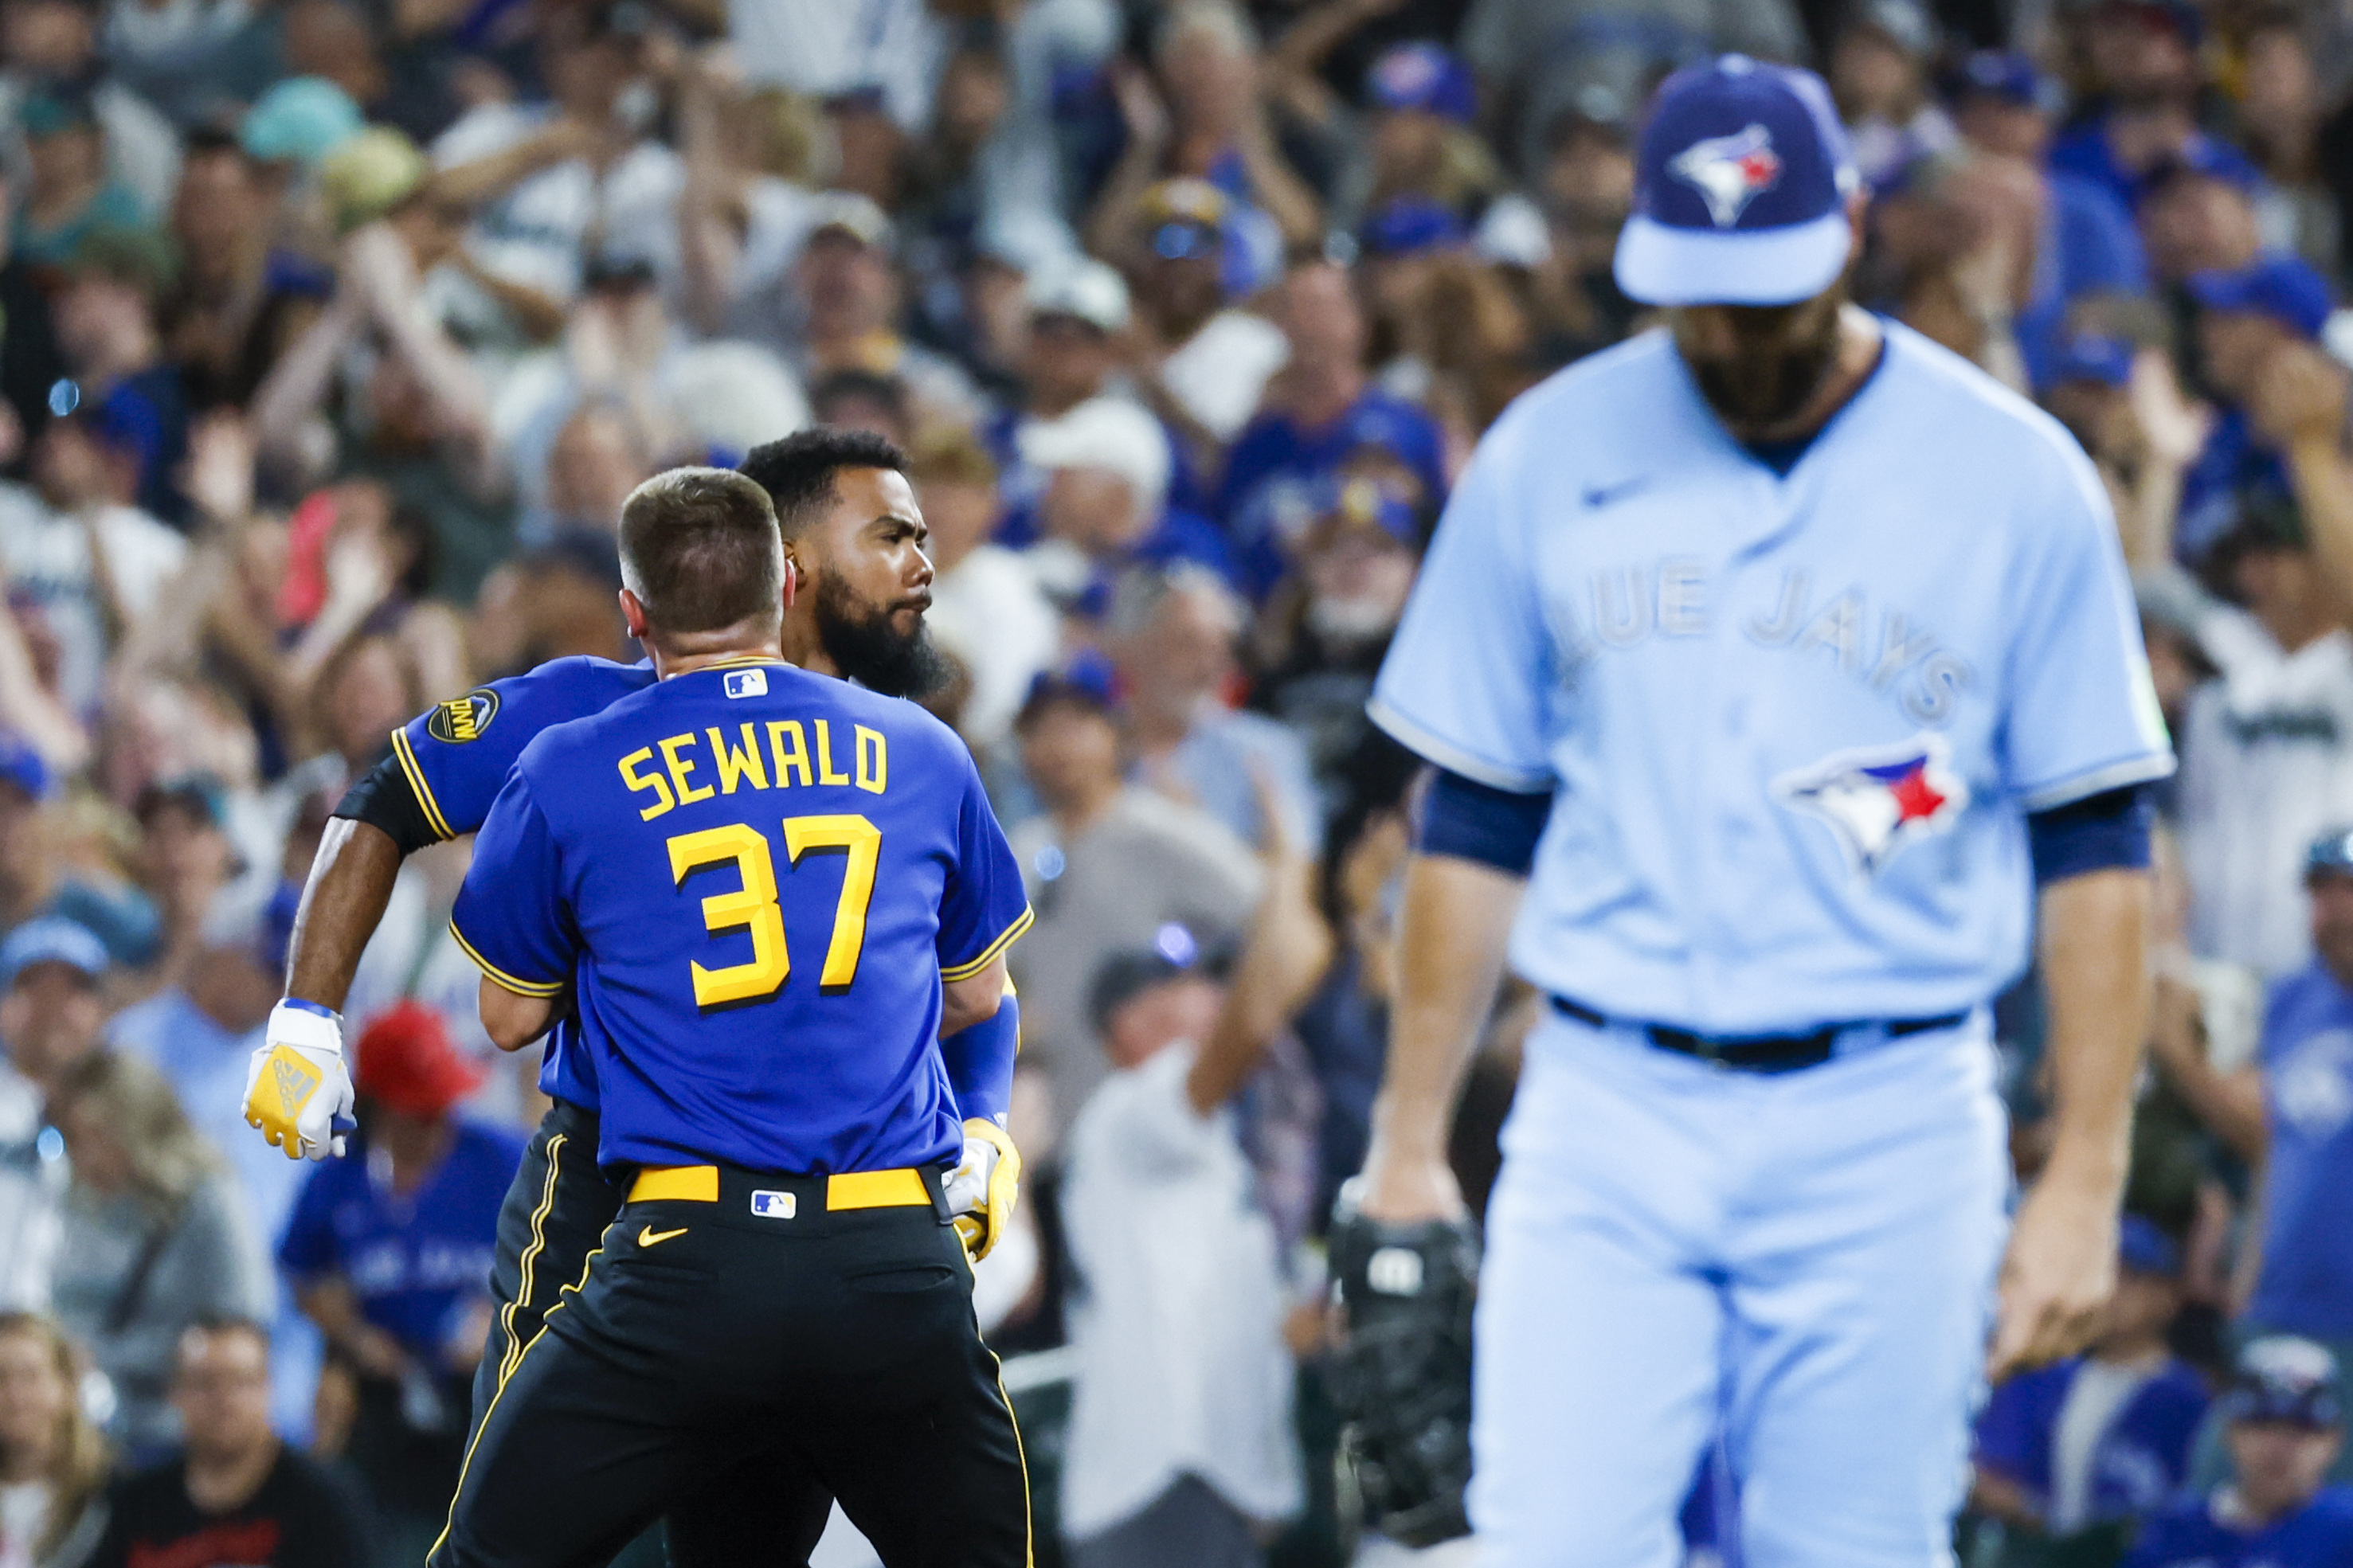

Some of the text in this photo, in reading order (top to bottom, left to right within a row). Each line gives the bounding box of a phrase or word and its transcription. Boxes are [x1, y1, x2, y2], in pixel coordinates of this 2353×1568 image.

[1743, 564, 1979, 729] JAYS
[439, 698, 477, 739] PNW
[617, 719, 887, 822] SEWALD
[666, 814, 883, 1016] 37
